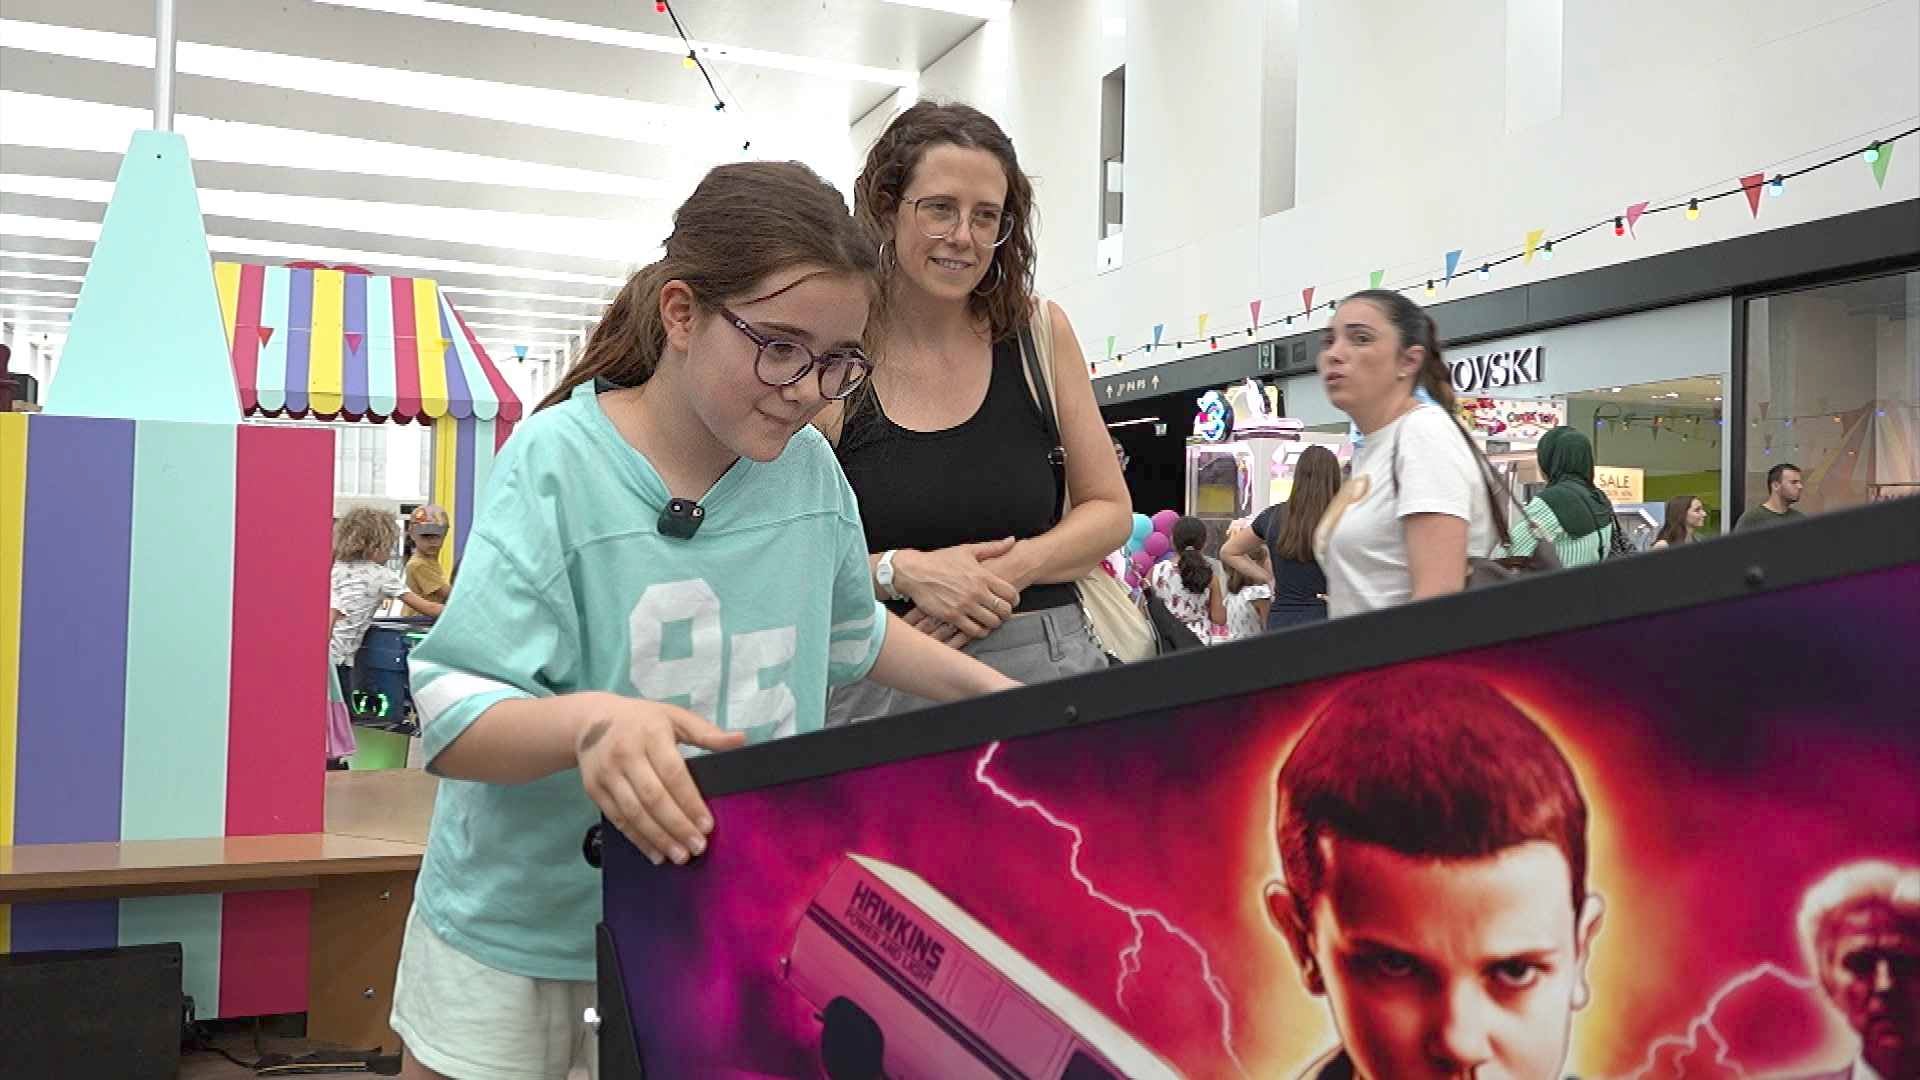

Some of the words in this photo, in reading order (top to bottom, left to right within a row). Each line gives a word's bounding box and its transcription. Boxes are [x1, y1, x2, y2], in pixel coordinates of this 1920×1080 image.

[1448, 345, 1544, 392] OVSKI
[1599, 473, 1630, 489] SALE
[629, 577, 797, 758] 95
[844, 906, 879, 942] POWER
[879, 936, 903, 961] AND
[901, 948, 934, 987] LIGHT
[851, 880, 945, 972] HAWKINS
